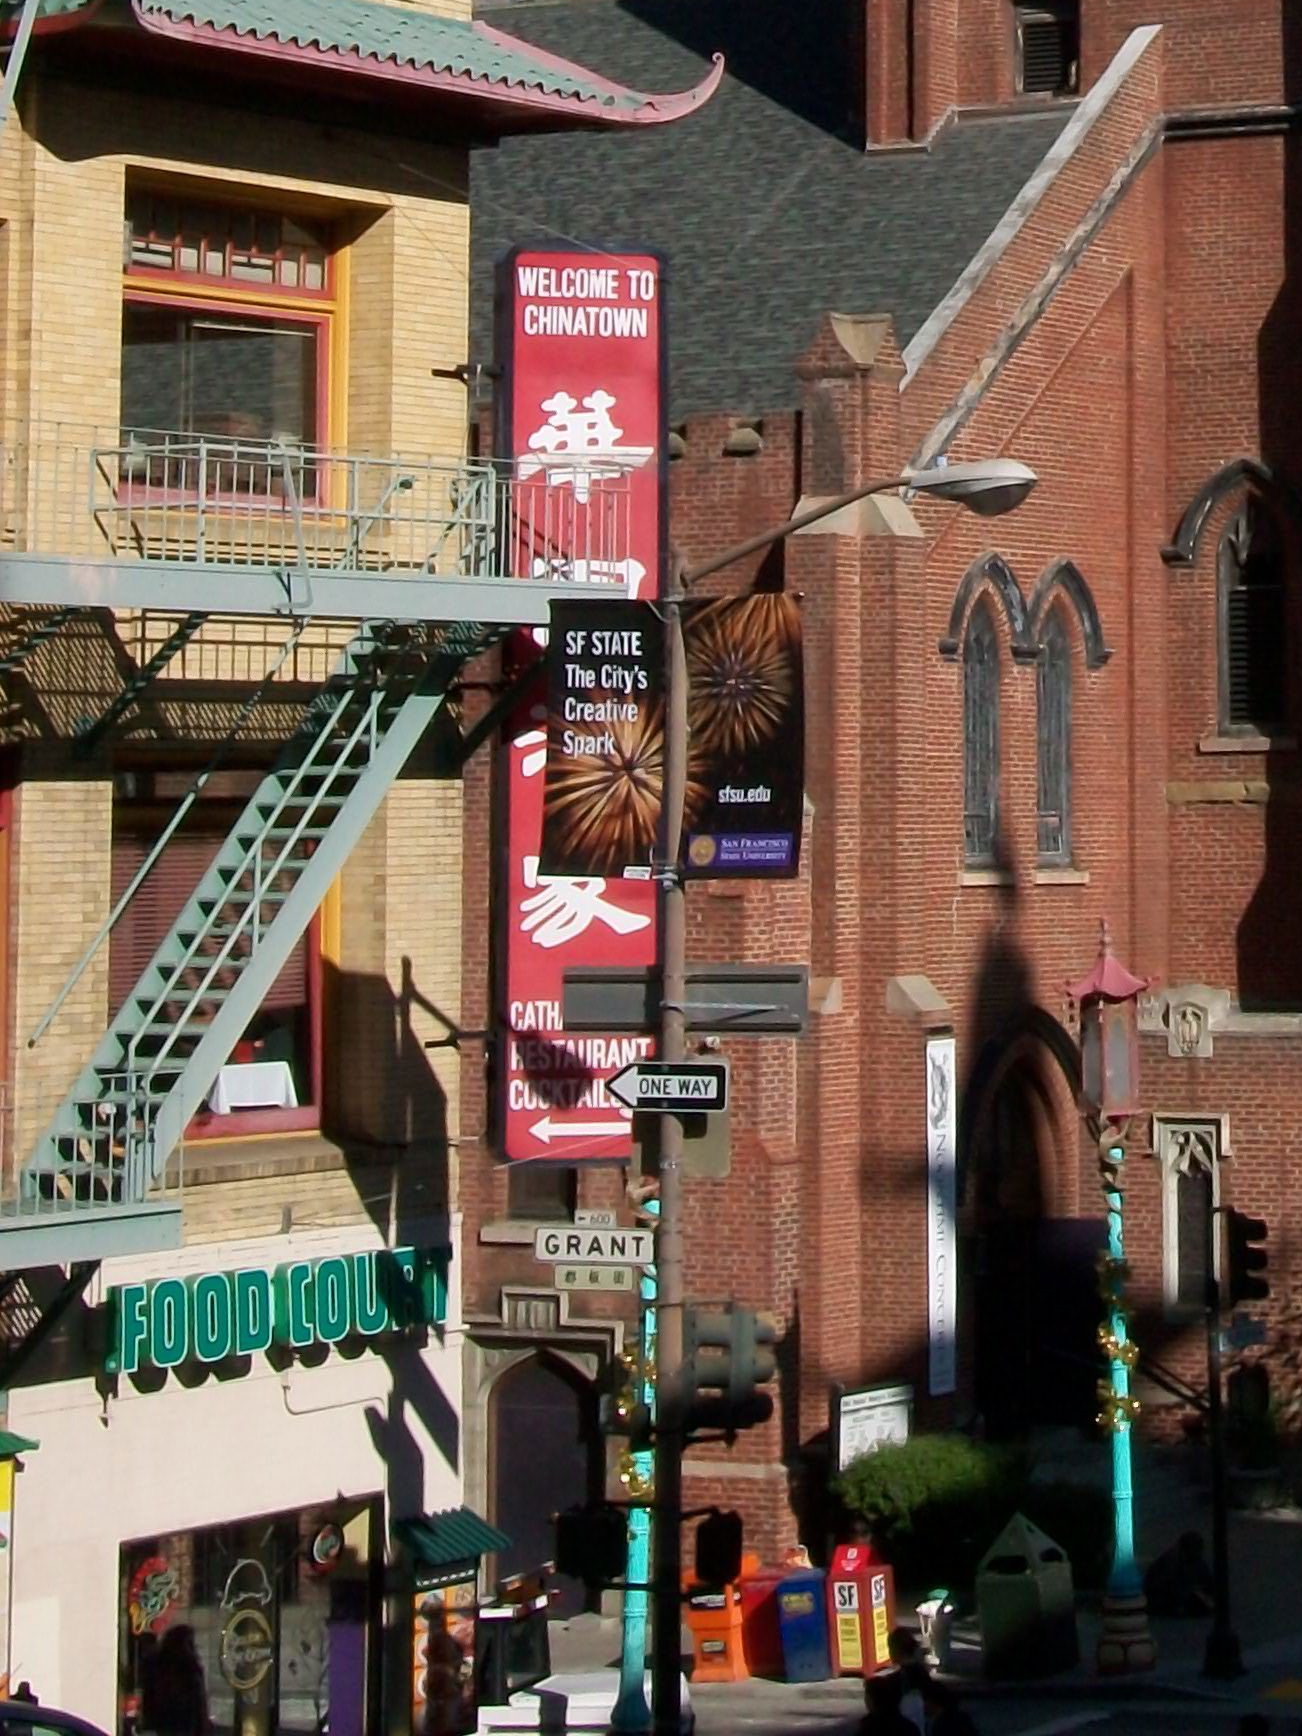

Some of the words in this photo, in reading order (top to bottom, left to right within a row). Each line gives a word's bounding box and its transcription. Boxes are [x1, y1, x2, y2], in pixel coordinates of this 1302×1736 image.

[517, 266, 620, 300] WELCOME
[626, 270, 655, 301] TO
[523, 304, 648, 338] CHINATOWN
[565, 630, 588, 656] SF
[591, 630, 643, 656] STATE
[565, 664, 596, 689] The
[601, 664, 648, 694] City's
[565, 697, 639, 723] Creative
[562, 729, 616, 760] Spark
[718, 784, 771, 804] sfsu.edu
[510, 1037, 652, 1072] RESTAURANT
[639, 1077, 673, 1097] ONE
[678, 1078, 713, 1097] WAY
[545, 1234, 645, 1257] GRANT
[122, 1267, 272, 1373] FOOD
[838, 1584, 854, 1607] SF
